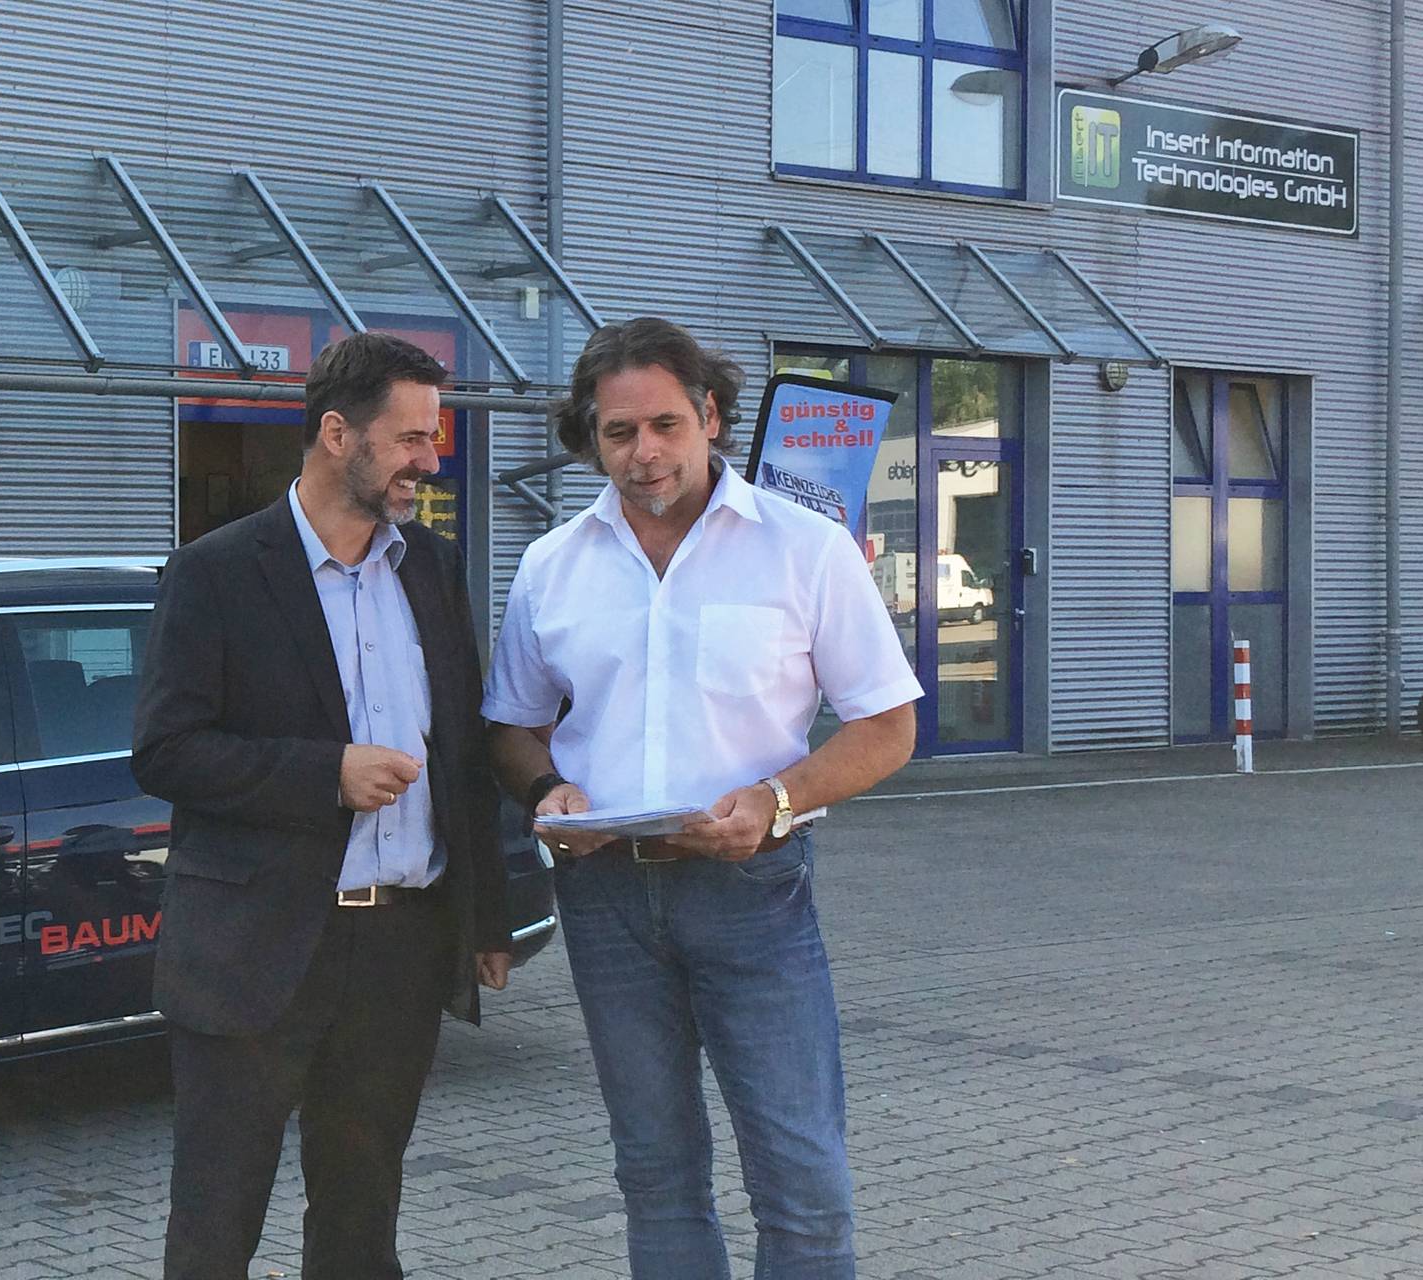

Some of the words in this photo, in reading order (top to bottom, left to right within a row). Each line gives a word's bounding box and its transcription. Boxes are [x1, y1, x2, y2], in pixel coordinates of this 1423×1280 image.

[1146, 124, 1210, 156] Insert
[1216, 135, 1334, 175] Information
[1131, 157, 1278, 200] Technologies
[1284, 181, 1347, 209] GmbH
[780, 401, 875, 423] günstig
[834, 419, 850, 433] &
[783, 430, 874, 449] schnell
[775, 468, 843, 504] KENNZEICHEN
